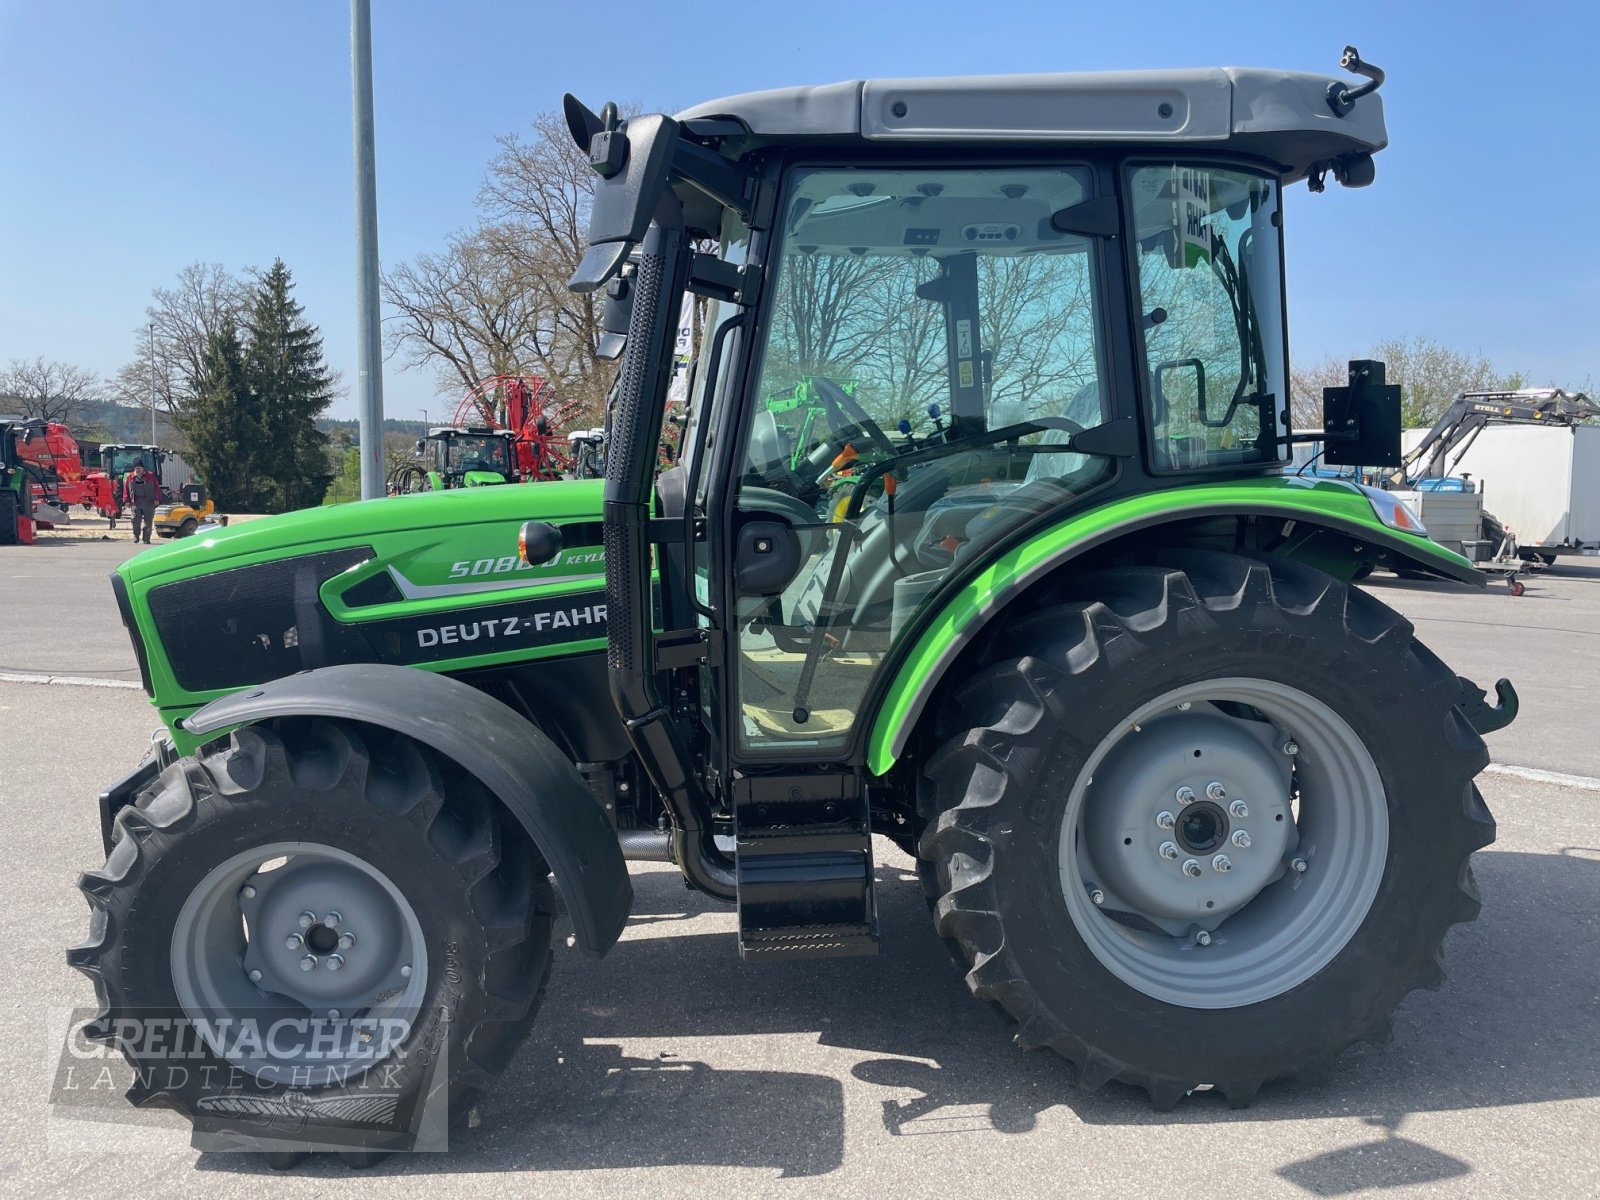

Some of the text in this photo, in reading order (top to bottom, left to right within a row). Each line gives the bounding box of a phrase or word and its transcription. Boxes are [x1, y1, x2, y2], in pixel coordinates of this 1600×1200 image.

[1474, 404, 1500, 413] STOLL
[566, 552, 606, 565] KEYLI
[417, 604, 608, 647] DEUTZ-FAHR
